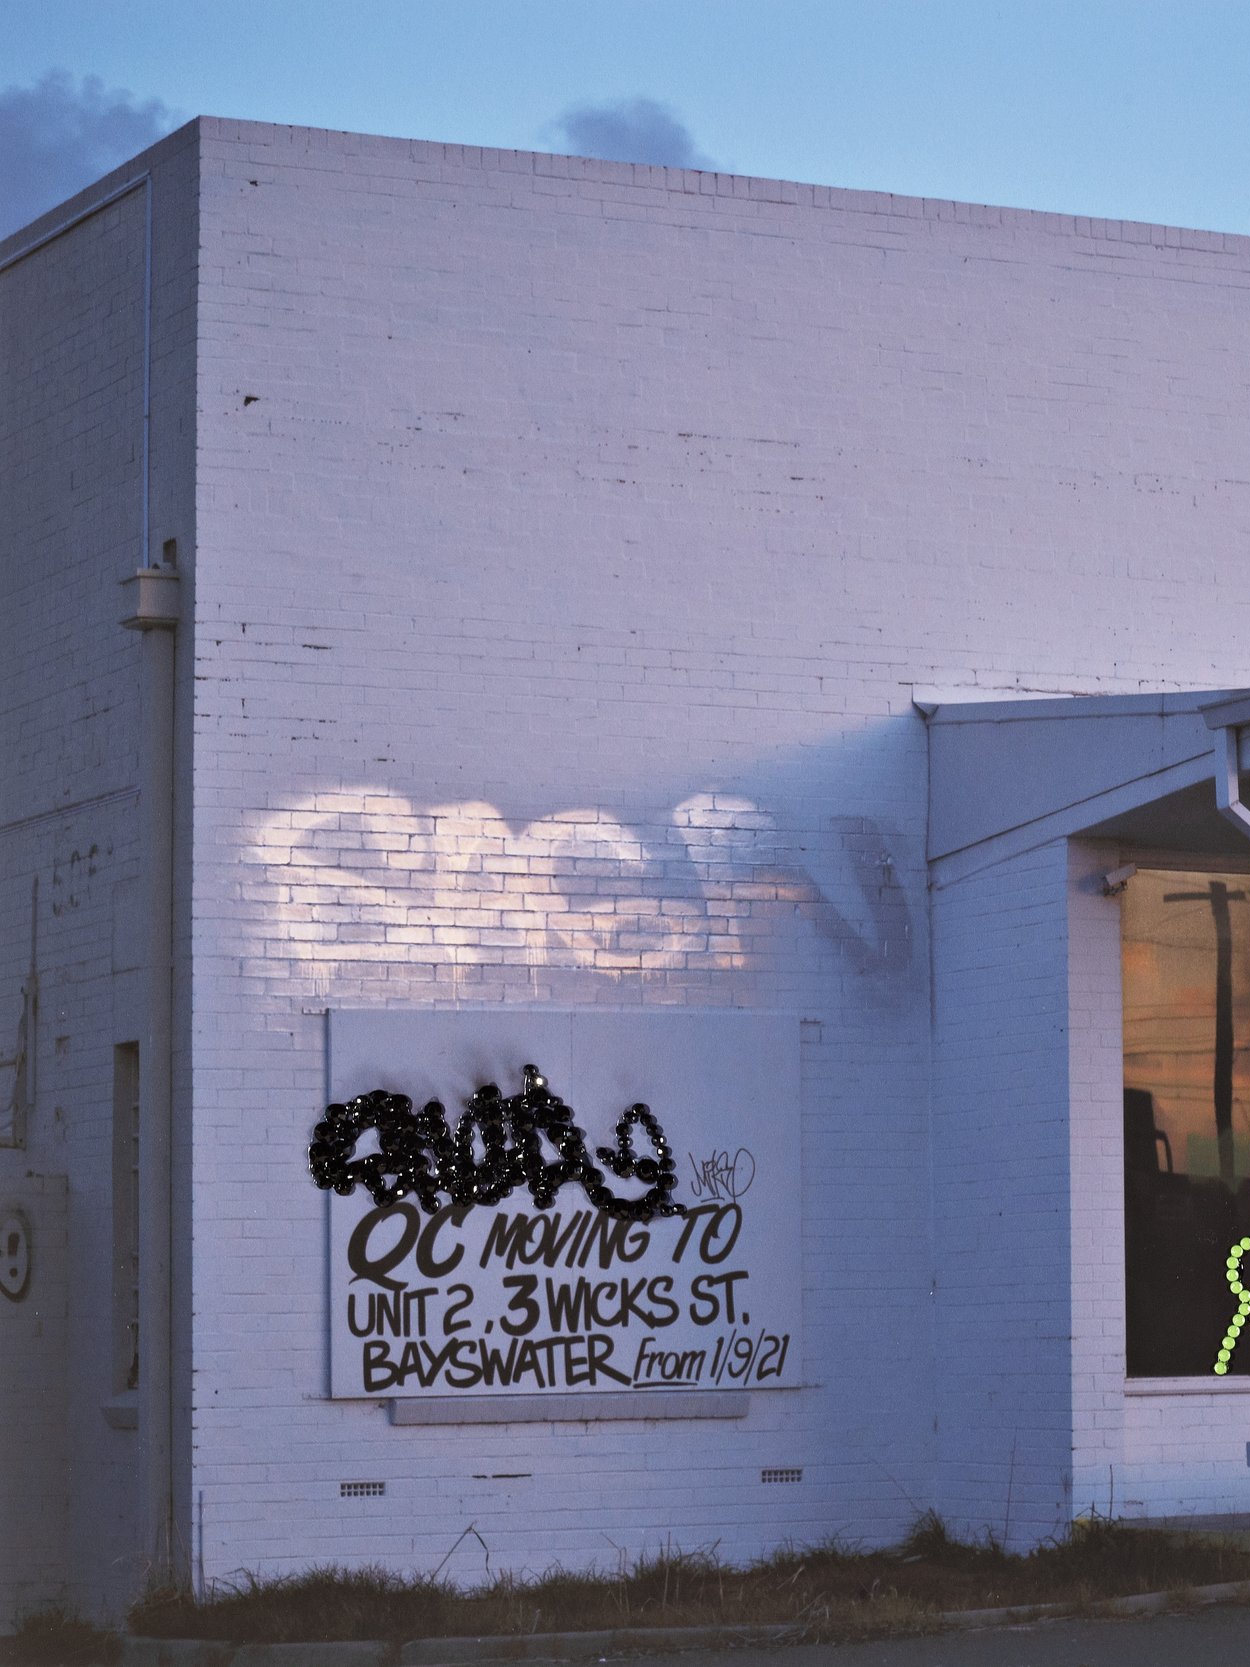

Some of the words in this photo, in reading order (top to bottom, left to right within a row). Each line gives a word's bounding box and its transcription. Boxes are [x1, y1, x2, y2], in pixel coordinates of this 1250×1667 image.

[347, 1201, 475, 1291] QC
[479, 1210, 651, 1270] MOVING
[672, 1203, 743, 1264] TO
[347, 1286, 440, 1338] UNIT
[500, 1274, 541, 1337] 3
[545, 1275, 680, 1333] WICKS
[689, 1270, 750, 1326] ST.
[362, 1333, 632, 1392] BAYSWATER
[709, 1328, 790, 1387] 1/9/21
